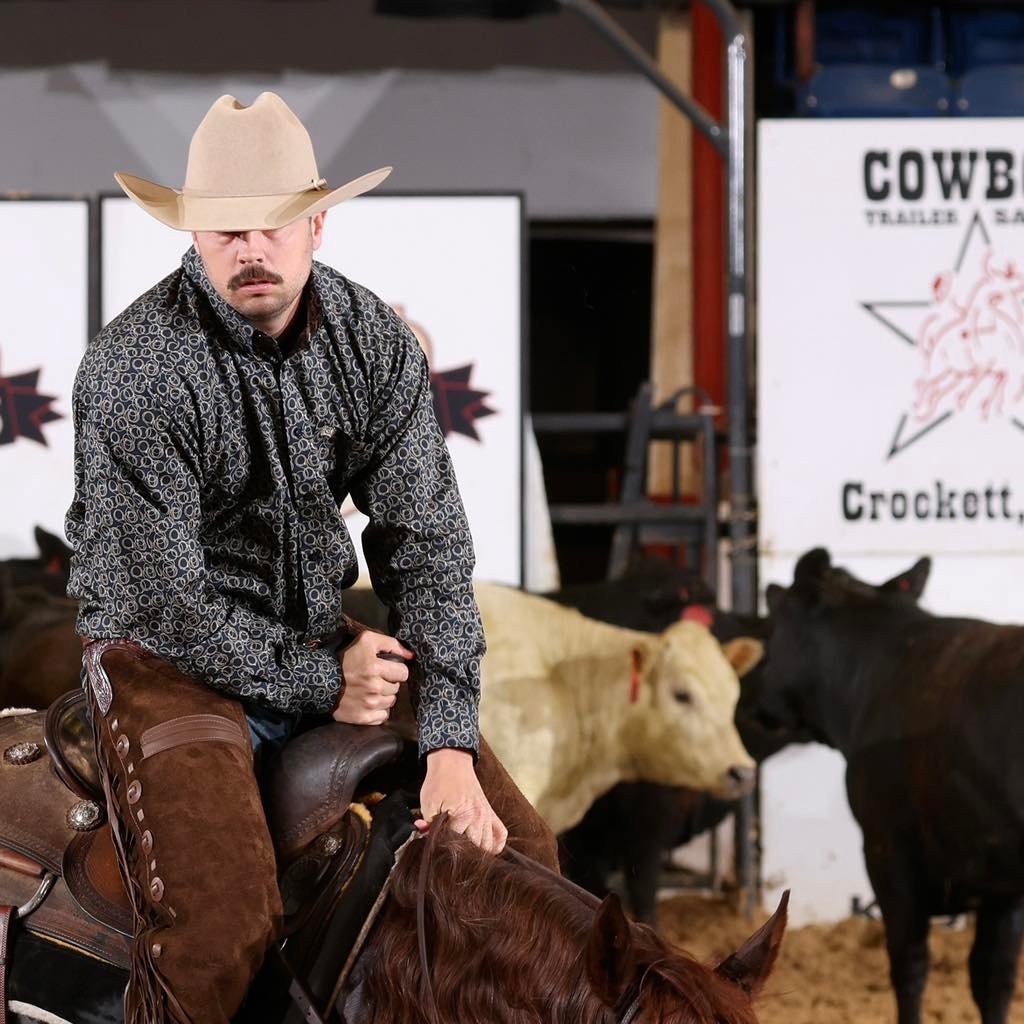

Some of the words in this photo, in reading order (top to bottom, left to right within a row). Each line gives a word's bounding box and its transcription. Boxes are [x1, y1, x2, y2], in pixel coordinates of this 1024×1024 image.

[863, 149, 1024, 202] COWB
[864, 209, 958, 226] TRAILER
[842, 480, 1024, 525] Crockett,
